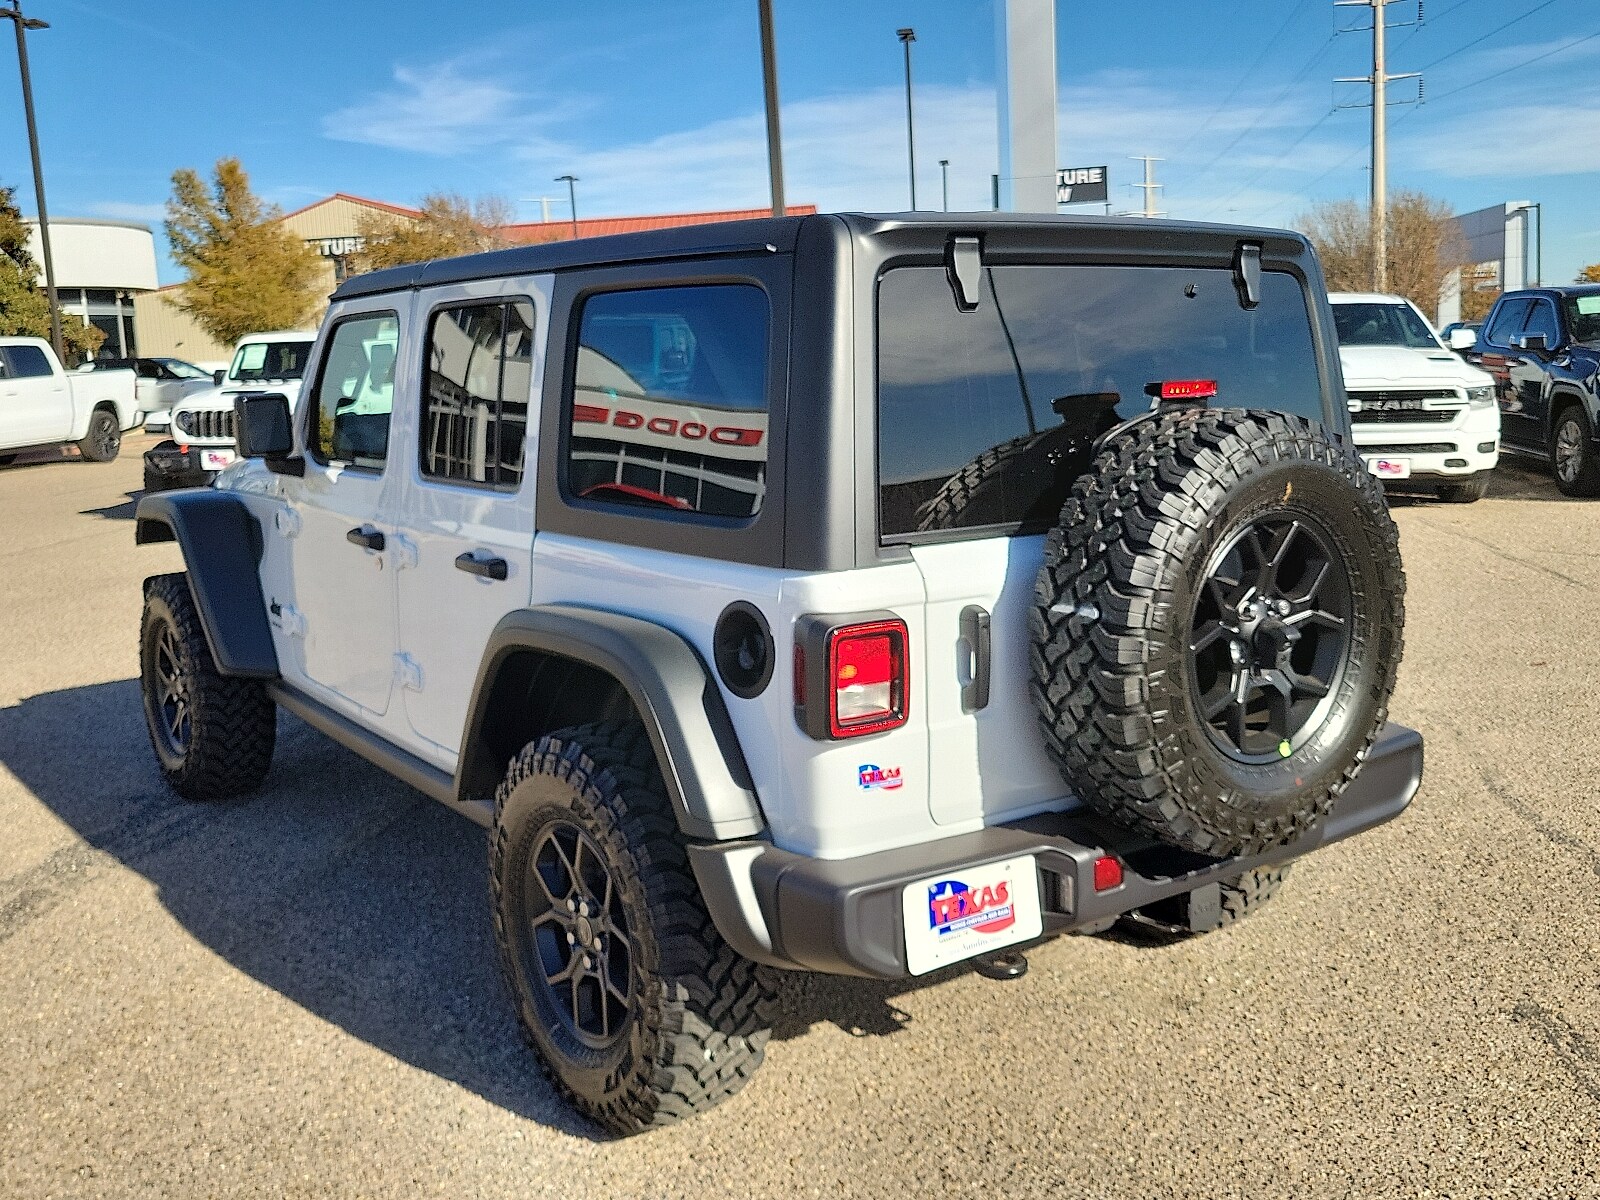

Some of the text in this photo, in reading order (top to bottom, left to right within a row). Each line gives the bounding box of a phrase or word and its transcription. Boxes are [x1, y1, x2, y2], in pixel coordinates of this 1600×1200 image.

[1361, 400, 1422, 411] RAM
[861, 767, 900, 784] TEXAS
[931, 881, 1009, 925] TEXAS
